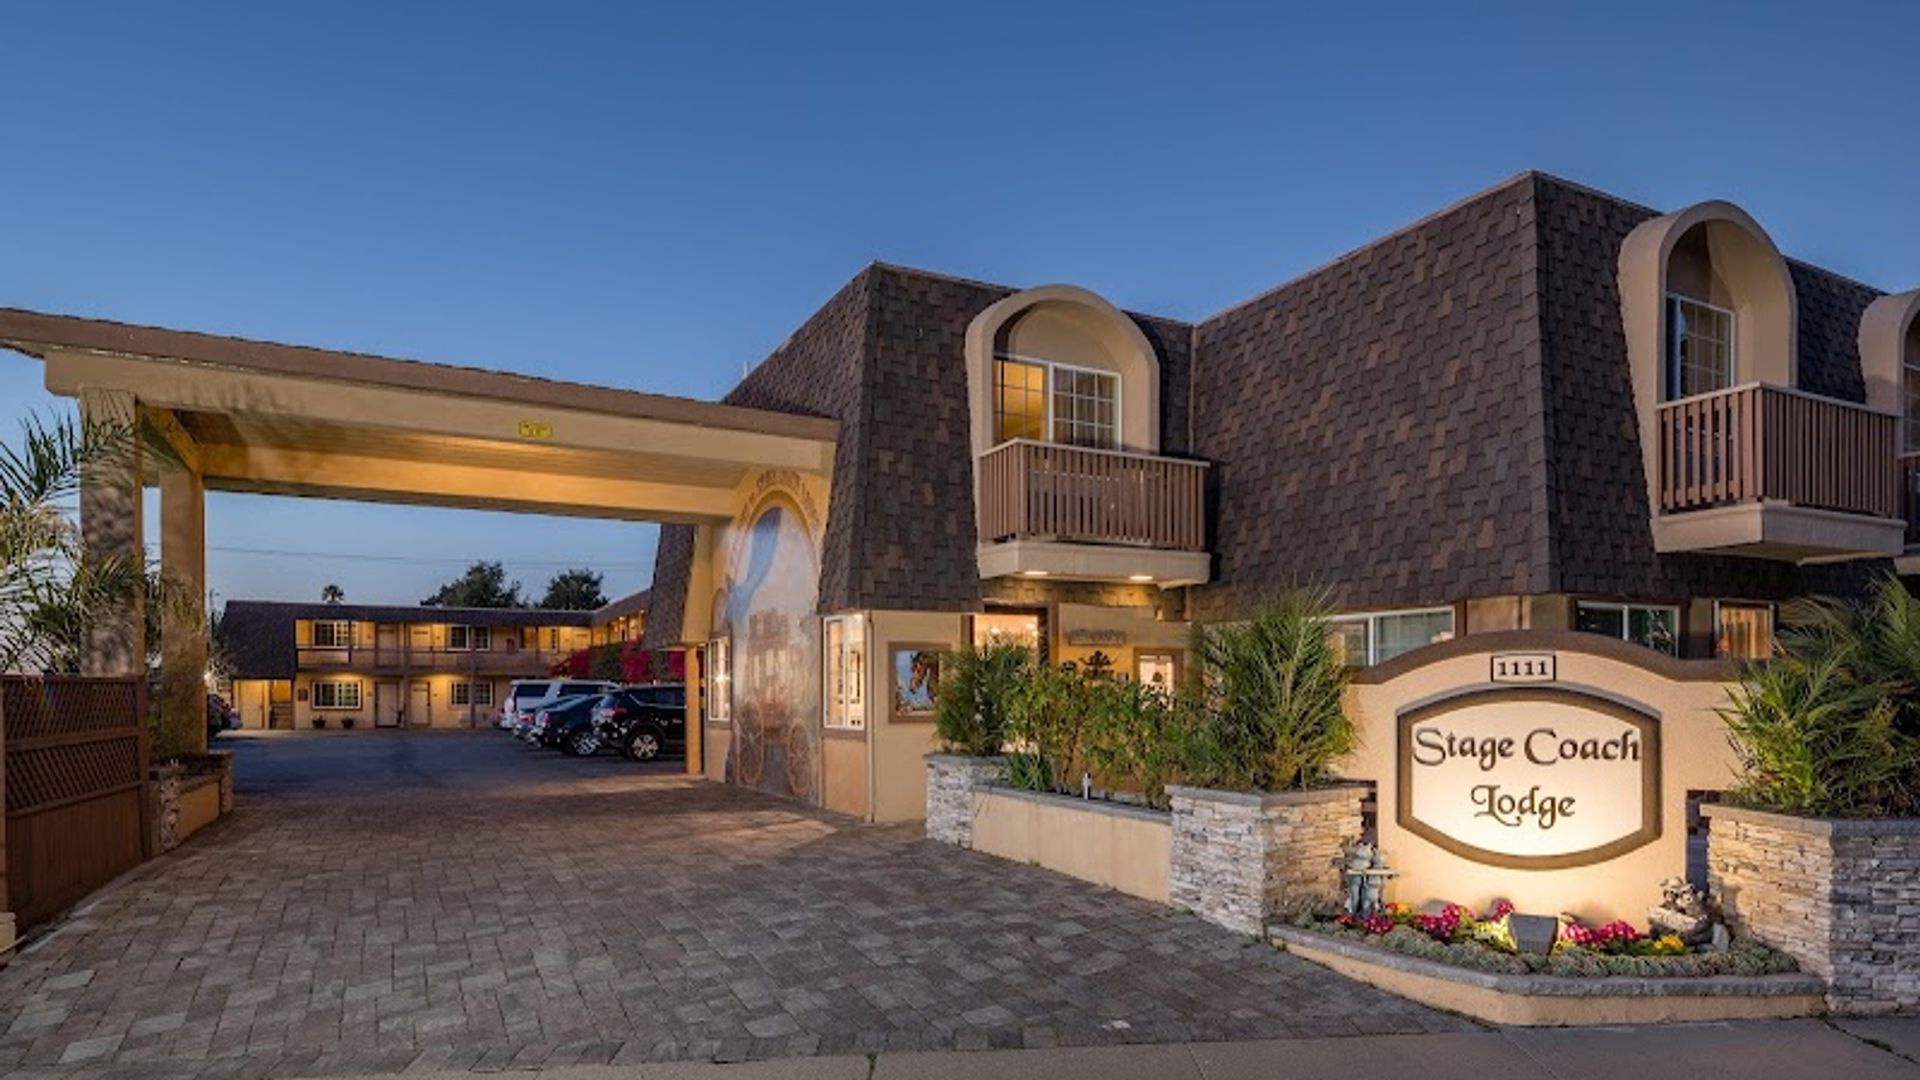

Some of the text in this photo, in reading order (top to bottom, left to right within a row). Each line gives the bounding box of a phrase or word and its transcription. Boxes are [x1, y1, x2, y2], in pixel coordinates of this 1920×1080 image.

[1498, 660, 1548, 676] 1111
[1413, 727, 1640, 771] Stage Coach
[1470, 784, 1576, 829] Lodge
